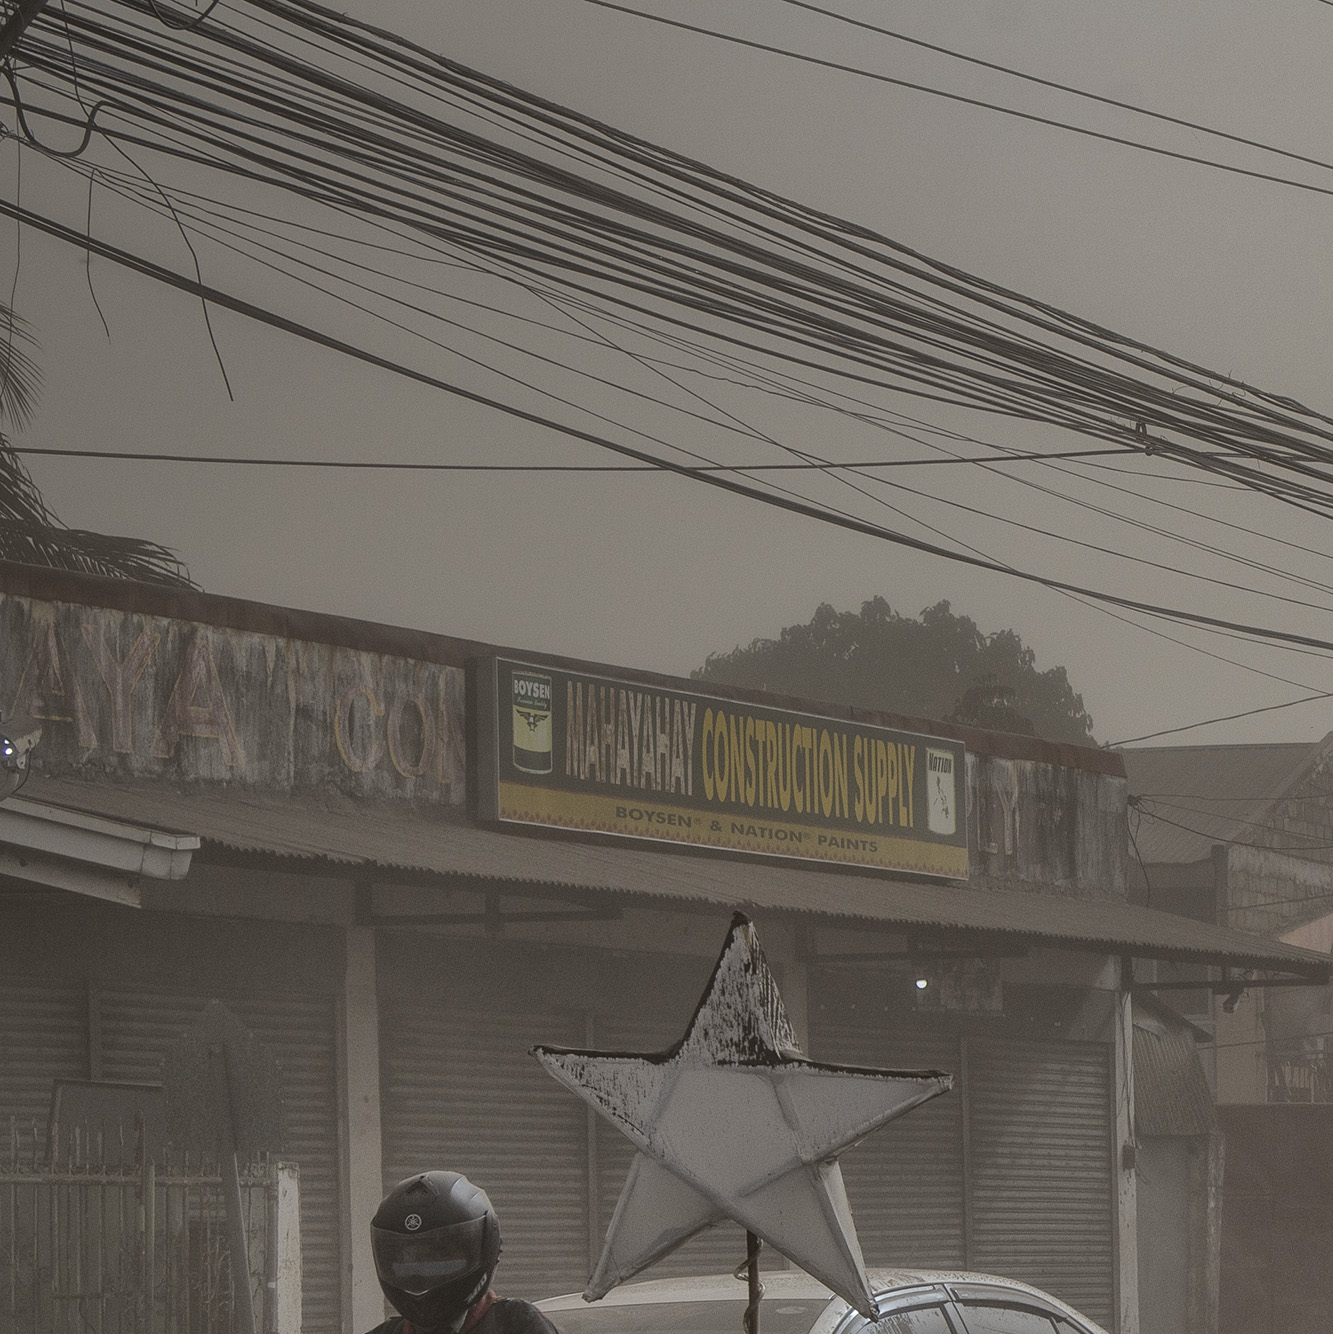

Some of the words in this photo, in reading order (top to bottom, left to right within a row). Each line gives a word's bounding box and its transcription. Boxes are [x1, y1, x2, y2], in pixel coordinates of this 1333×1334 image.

[513, 679, 550, 699] BOYSEN
[566, 680, 697, 796] MAHAYAHAY
[702, 707, 849, 819] CONSTRUCTION
[854, 734, 916, 828] SUPPLY
[709, 819, 723, 832] &
[817, 834, 879, 853] PAINTS
